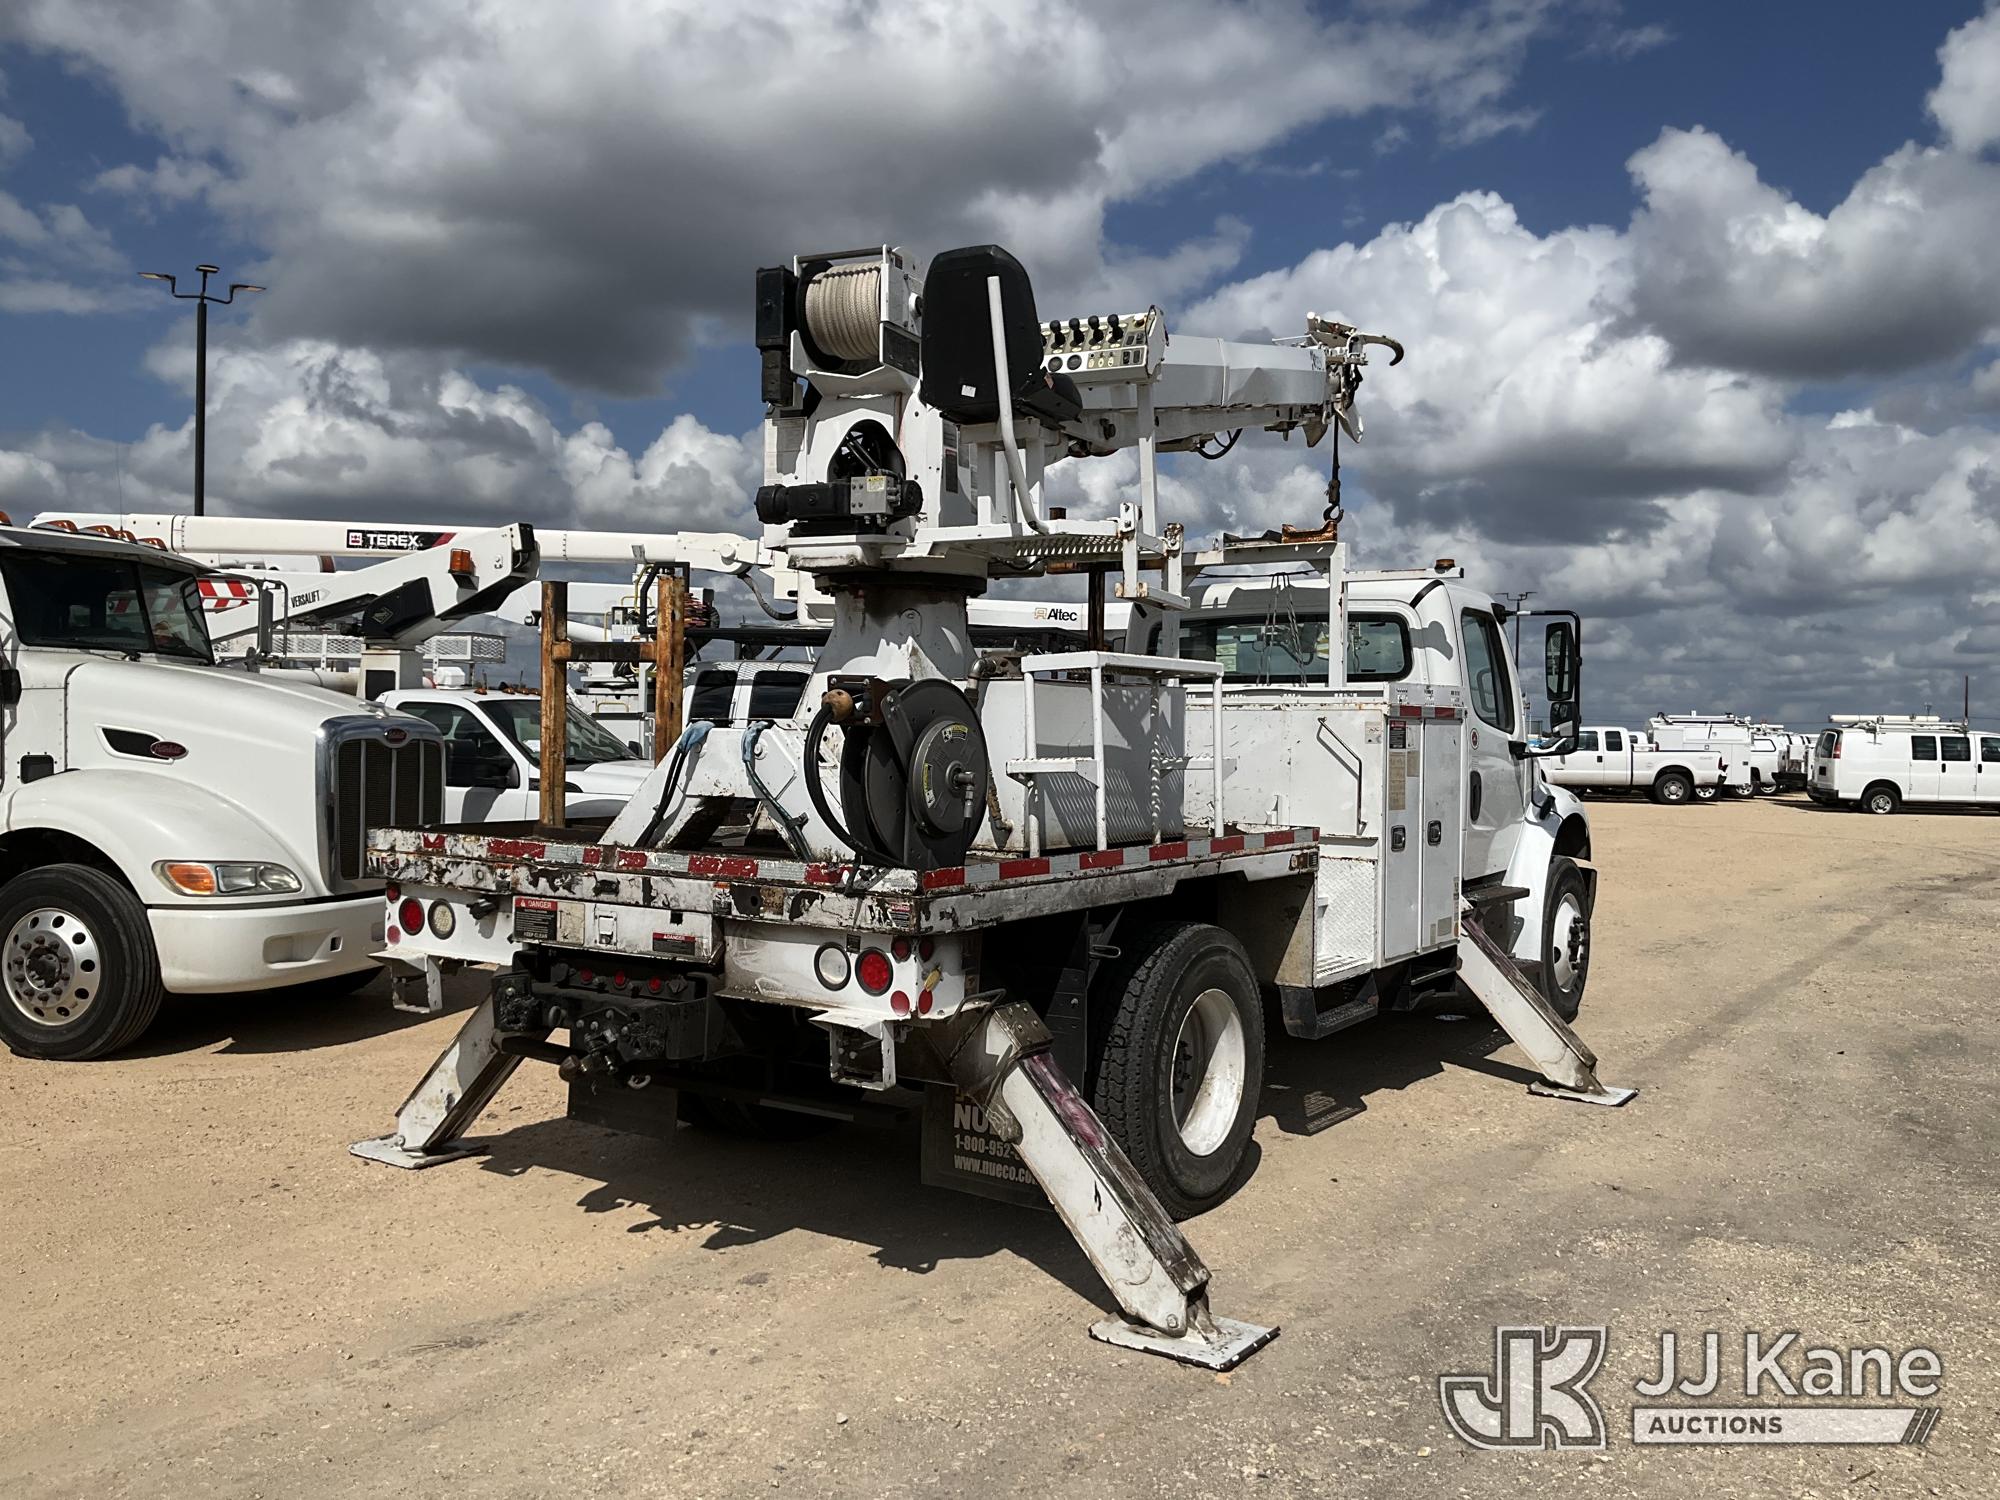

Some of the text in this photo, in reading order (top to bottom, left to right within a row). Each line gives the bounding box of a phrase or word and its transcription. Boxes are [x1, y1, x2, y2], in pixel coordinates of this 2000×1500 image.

[366, 533, 419, 547] TEREX
[291, 590, 320, 608] VERSALIFT
[1047, 608, 1077, 621] Altec
[527, 900, 552, 909] DANGER
[953, 1103, 999, 1135] NU
[953, 1154, 1039, 1185] www.nueco.co
